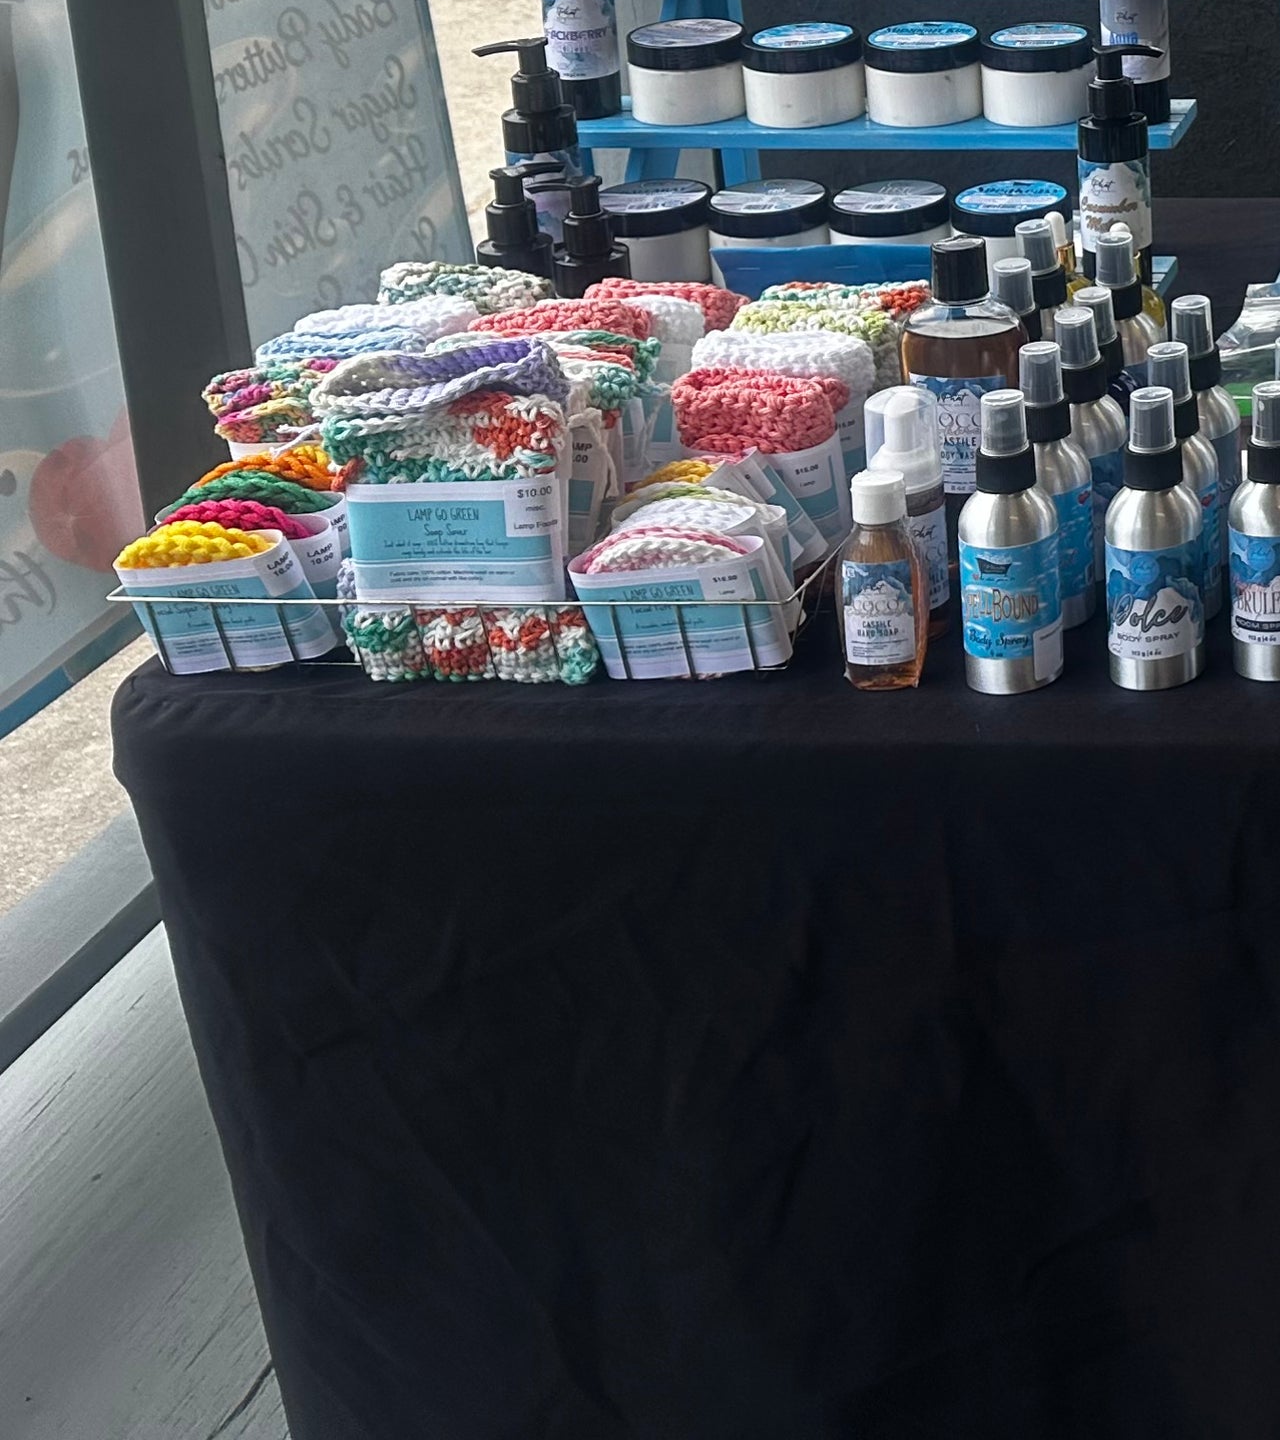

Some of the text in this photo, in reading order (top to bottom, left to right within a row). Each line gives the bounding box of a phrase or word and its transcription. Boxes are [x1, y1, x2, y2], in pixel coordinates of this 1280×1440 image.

[572, 442, 593, 453] AMP
[517, 485, 552, 499] $10.00
[407, 507, 480, 522] LAMP GO GREEN
[306, 543, 332, 559] LAMP
[266, 551, 289, 571] LAMP
[1113, 593, 1189, 633] Dolce
[1117, 631, 1180, 643] BODY SPRAY
